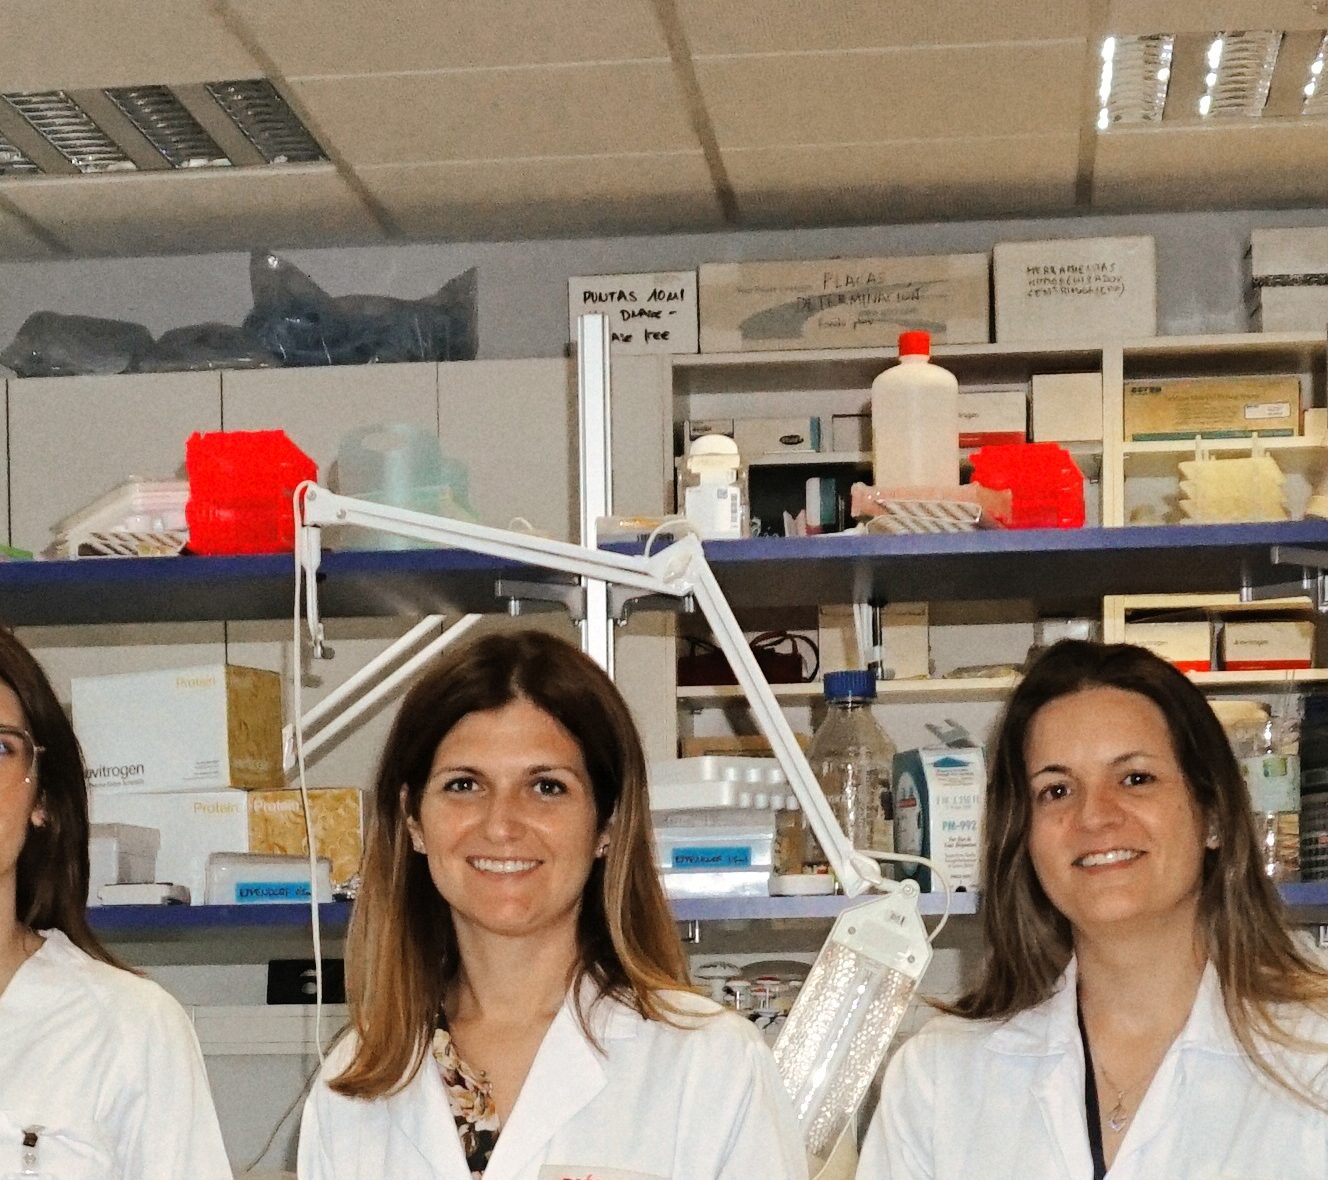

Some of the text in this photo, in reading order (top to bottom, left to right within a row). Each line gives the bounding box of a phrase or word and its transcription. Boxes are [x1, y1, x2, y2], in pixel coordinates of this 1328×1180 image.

[583, 288, 638, 304] PUNTAS
[175, 675, 216, 690] Protein
[86, 762, 145, 779] nvitrogen
[192, 800, 240, 816] Protein
[252, 798, 301, 814] Protein
